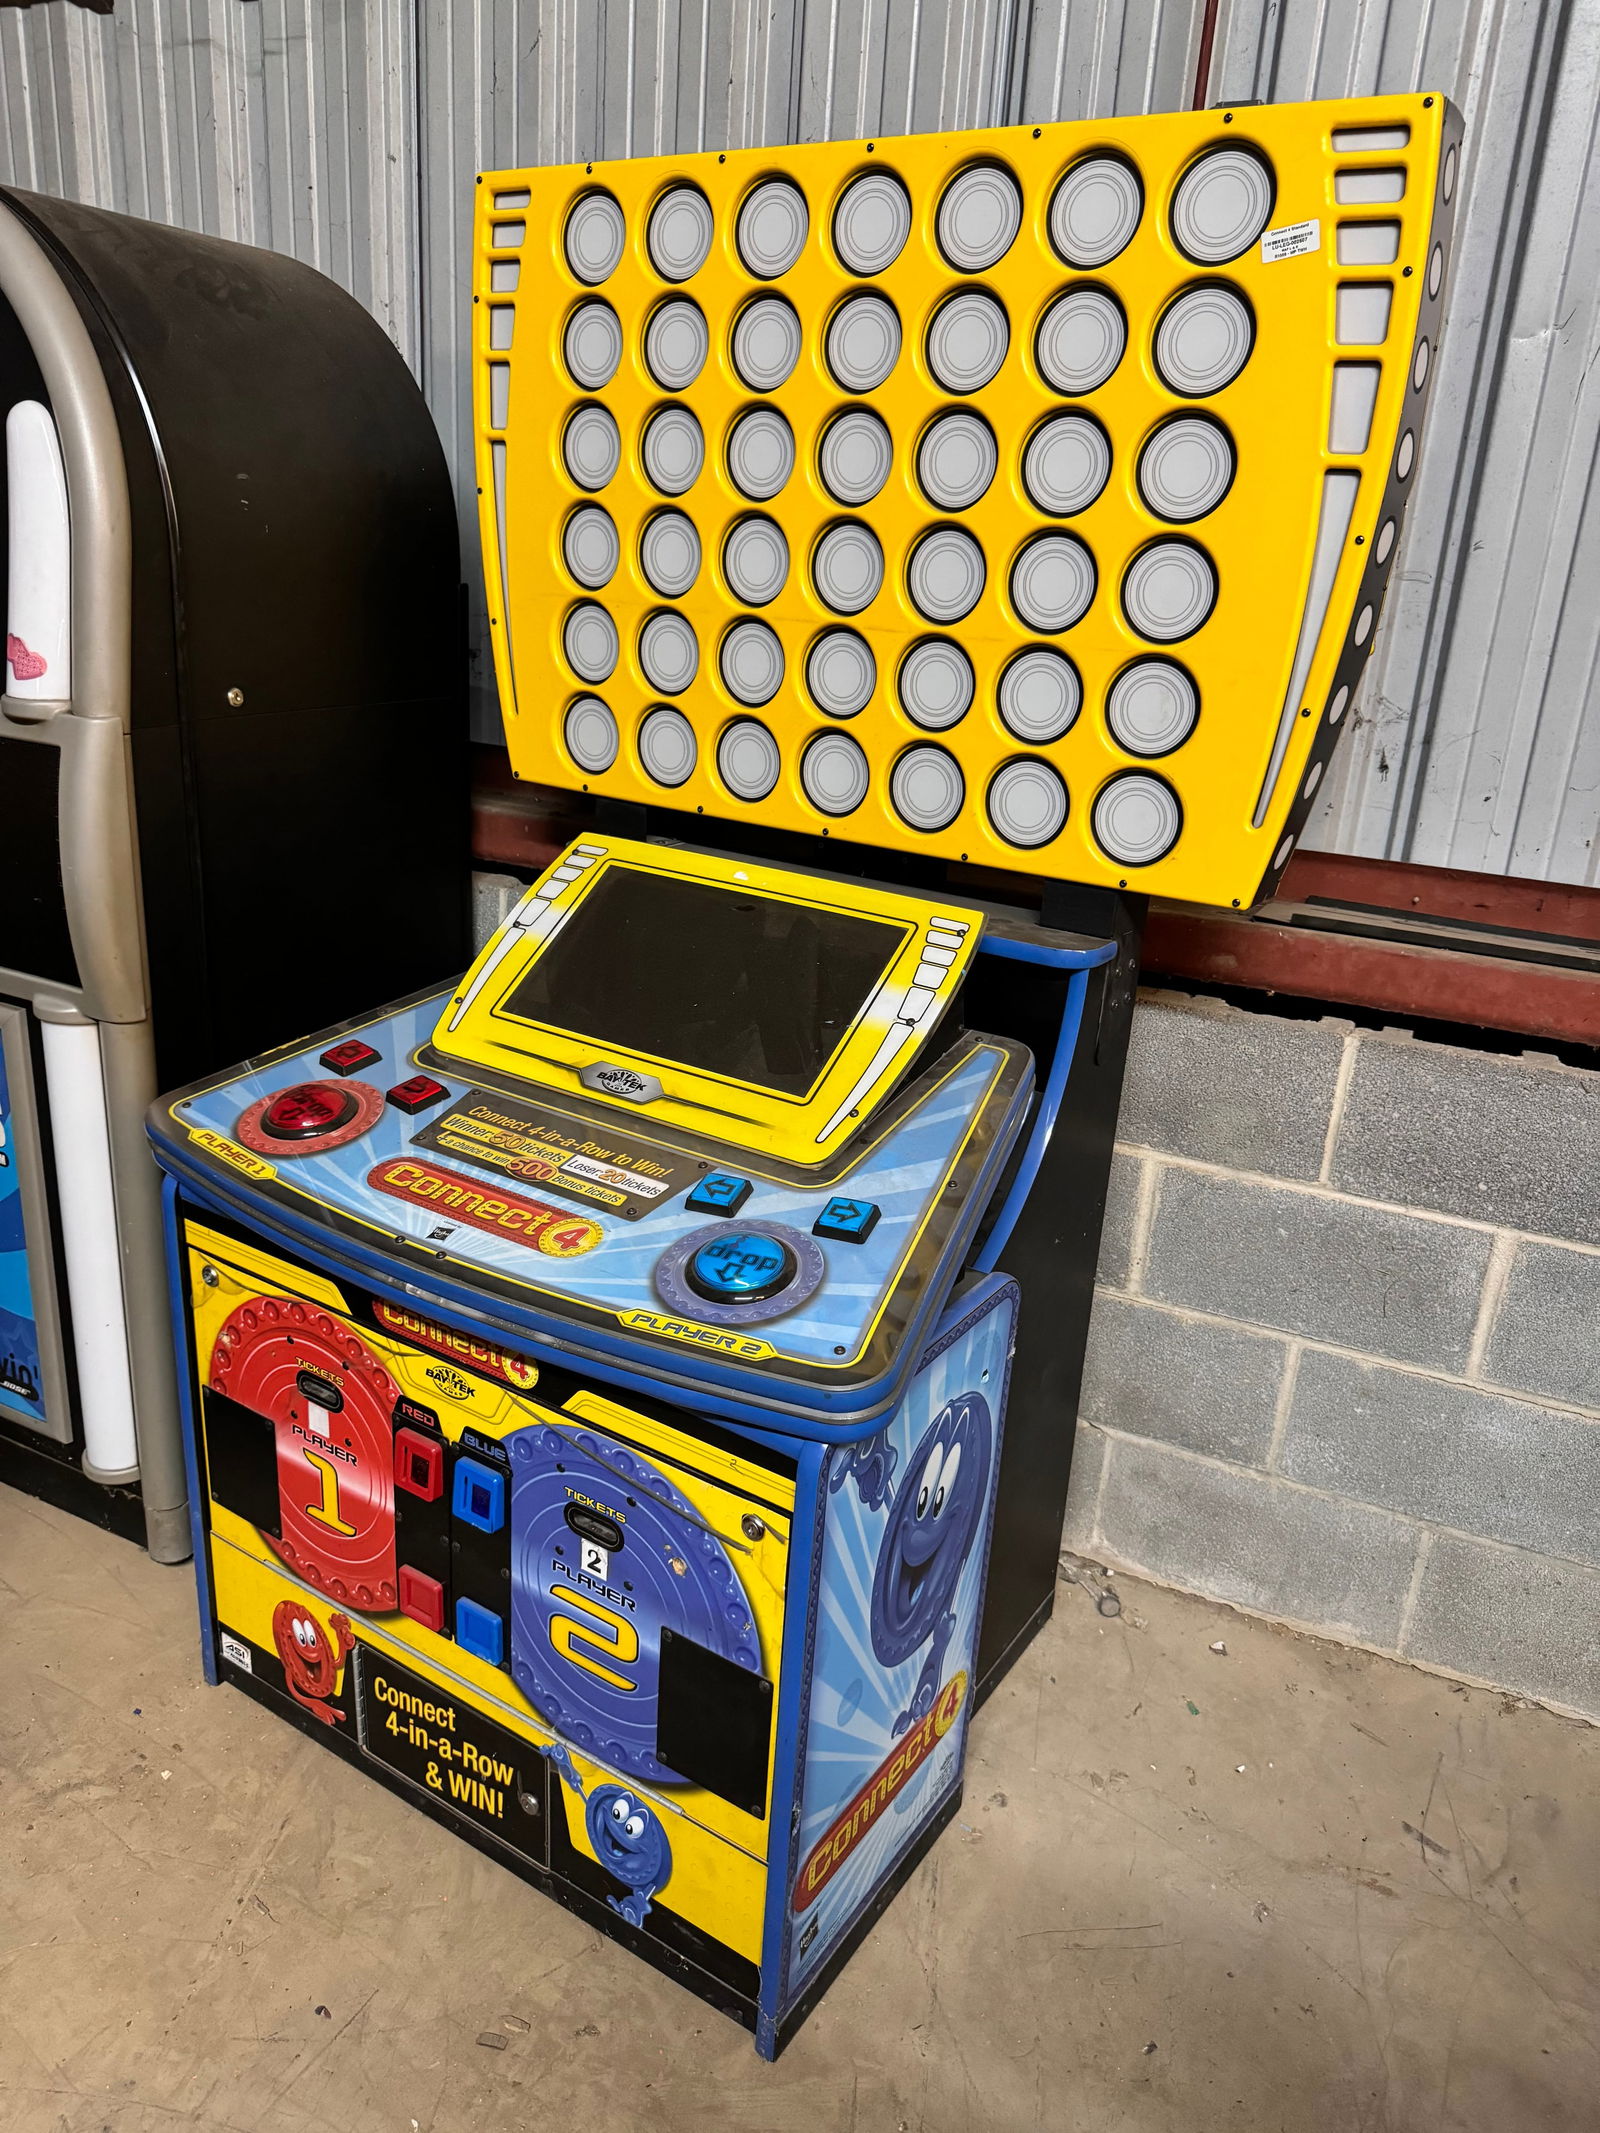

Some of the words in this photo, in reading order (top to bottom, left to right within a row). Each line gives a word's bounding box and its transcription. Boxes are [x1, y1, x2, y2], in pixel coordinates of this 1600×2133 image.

[622, 1080, 647, 1091] TEK
[199, 1133, 257, 1169] PLAYER
[252, 1165, 266, 1176] 1
[468, 1106, 532, 1131] Connect
[528, 1126, 615, 1159] 4-in-a-Row
[612, 1153, 632, 1166] to
[631, 1159, 674, 1178] Win!
[489, 1131, 526, 1149] 50
[518, 1142, 565, 1162] tickets
[453, 1141, 483, 1154] chance
[482, 1150, 493, 1158] to
[493, 1156, 510, 1165] win
[507, 1157, 558, 1180] 500
[552, 1175, 585, 1191] Bonus
[585, 1186, 621, 1203] tickets
[567, 1160, 603, 1177] Loser:
[598, 1169, 627, 1184] 20
[621, 1177, 661, 1195] tickets
[384, 1165, 552, 1236] Connect
[553, 1226, 592, 1250] 4
[704, 1245, 779, 1271] drop
[631, 1314, 736, 1349] PLAYER
[740, 1343, 762, 1354] 2
[296, 1357, 344, 1387] TICKETS
[451, 1380, 476, 1397] TEK
[402, 1403, 435, 1427] RED
[292, 1425, 358, 1467] PLAYER
[464, 1433, 507, 1461] BLUE
[303, 1447, 357, 1537] 1
[564, 1486, 627, 1524] TICKETS
[587, 1549, 602, 1574] 2
[552, 1559, 636, 1612] PLAYER
[549, 1584, 639, 1691] 2
[374, 1676, 457, 1732] Connect
[385, 1711, 514, 1787] 4-in-a-Row
[425, 1761, 443, 1792] &
[448, 1769, 504, 1819] WIN!
[808, 1715, 934, 1892] Connect
[942, 1683, 959, 1720] 4
